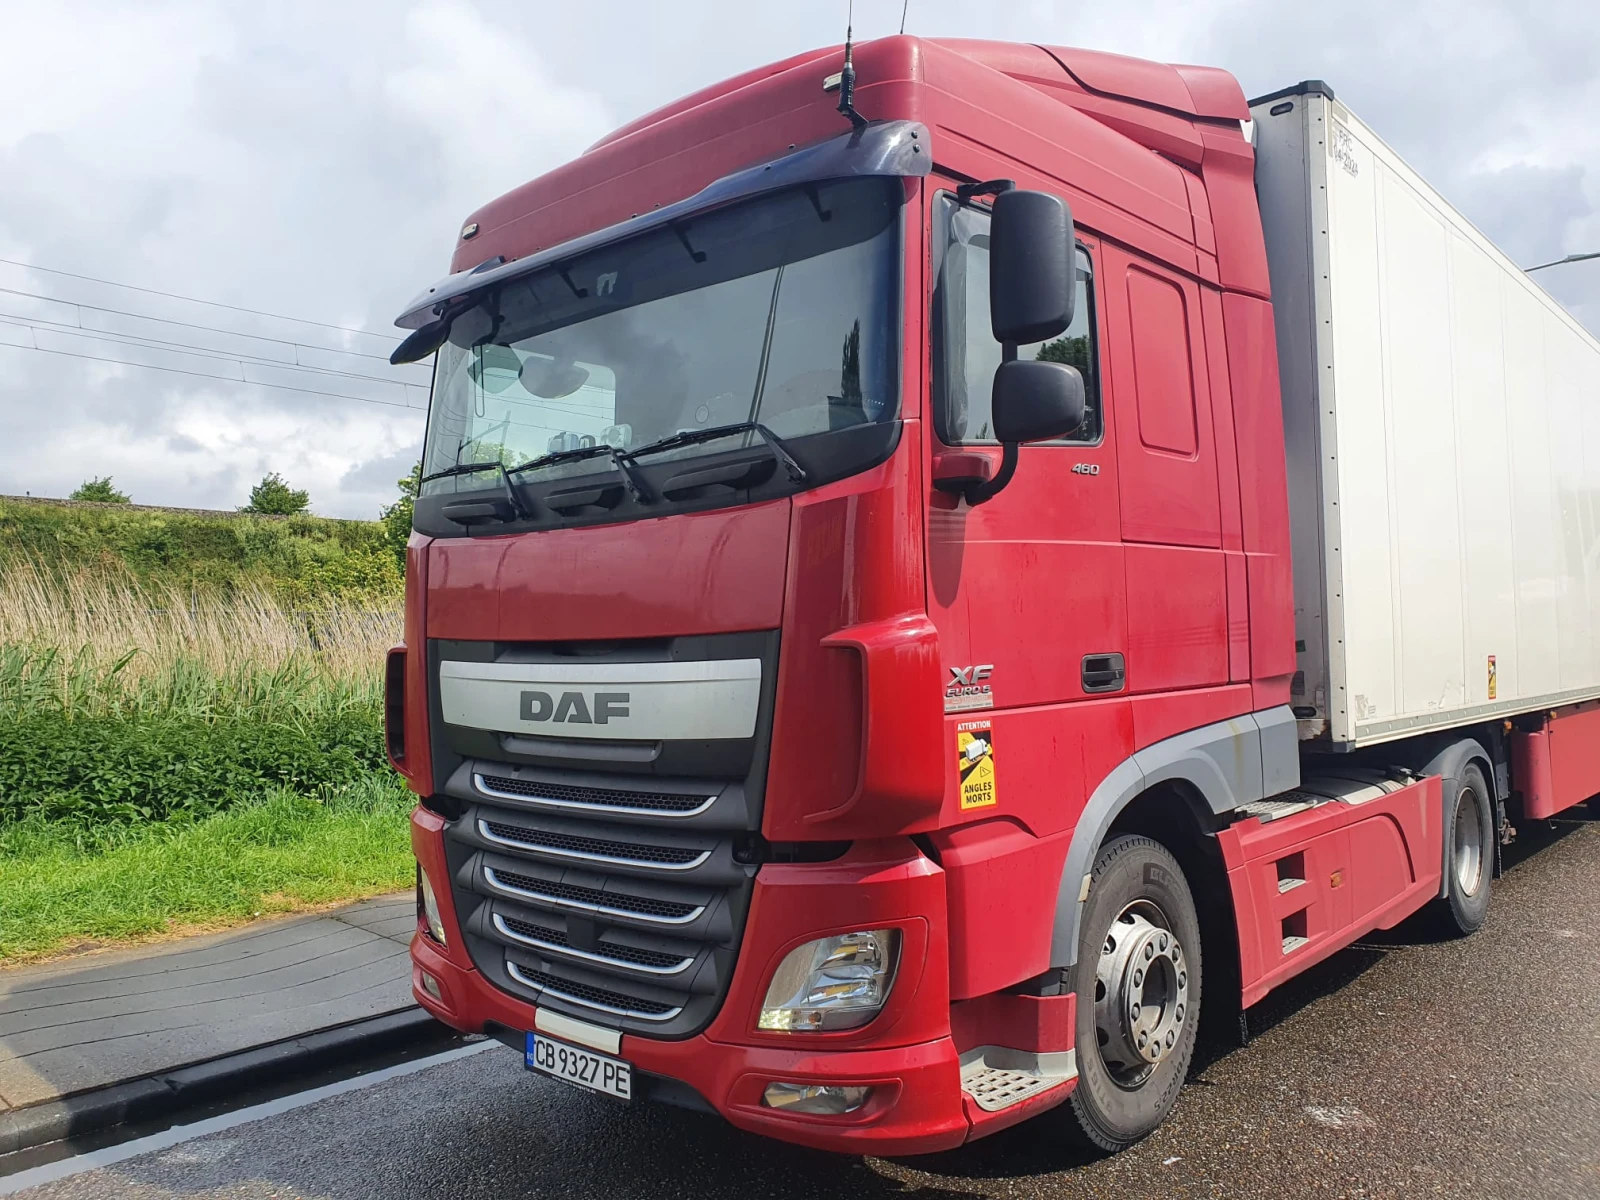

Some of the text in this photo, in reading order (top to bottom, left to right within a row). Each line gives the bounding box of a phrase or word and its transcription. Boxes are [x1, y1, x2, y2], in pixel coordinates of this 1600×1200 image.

[1071, 463, 1100, 476] 460
[947, 664, 994, 687] XF
[945, 684, 991, 698] EURO 6
[519, 690, 630, 724] DAF
[957, 720, 991, 731] ATTENTION
[964, 781, 992, 794] ANGLES
[966, 792, 992, 804] MORTS
[536, 1040, 556, 1070] CB
[558, 1048, 600, 1084] 9327
[603, 1061, 631, 1095] PE
